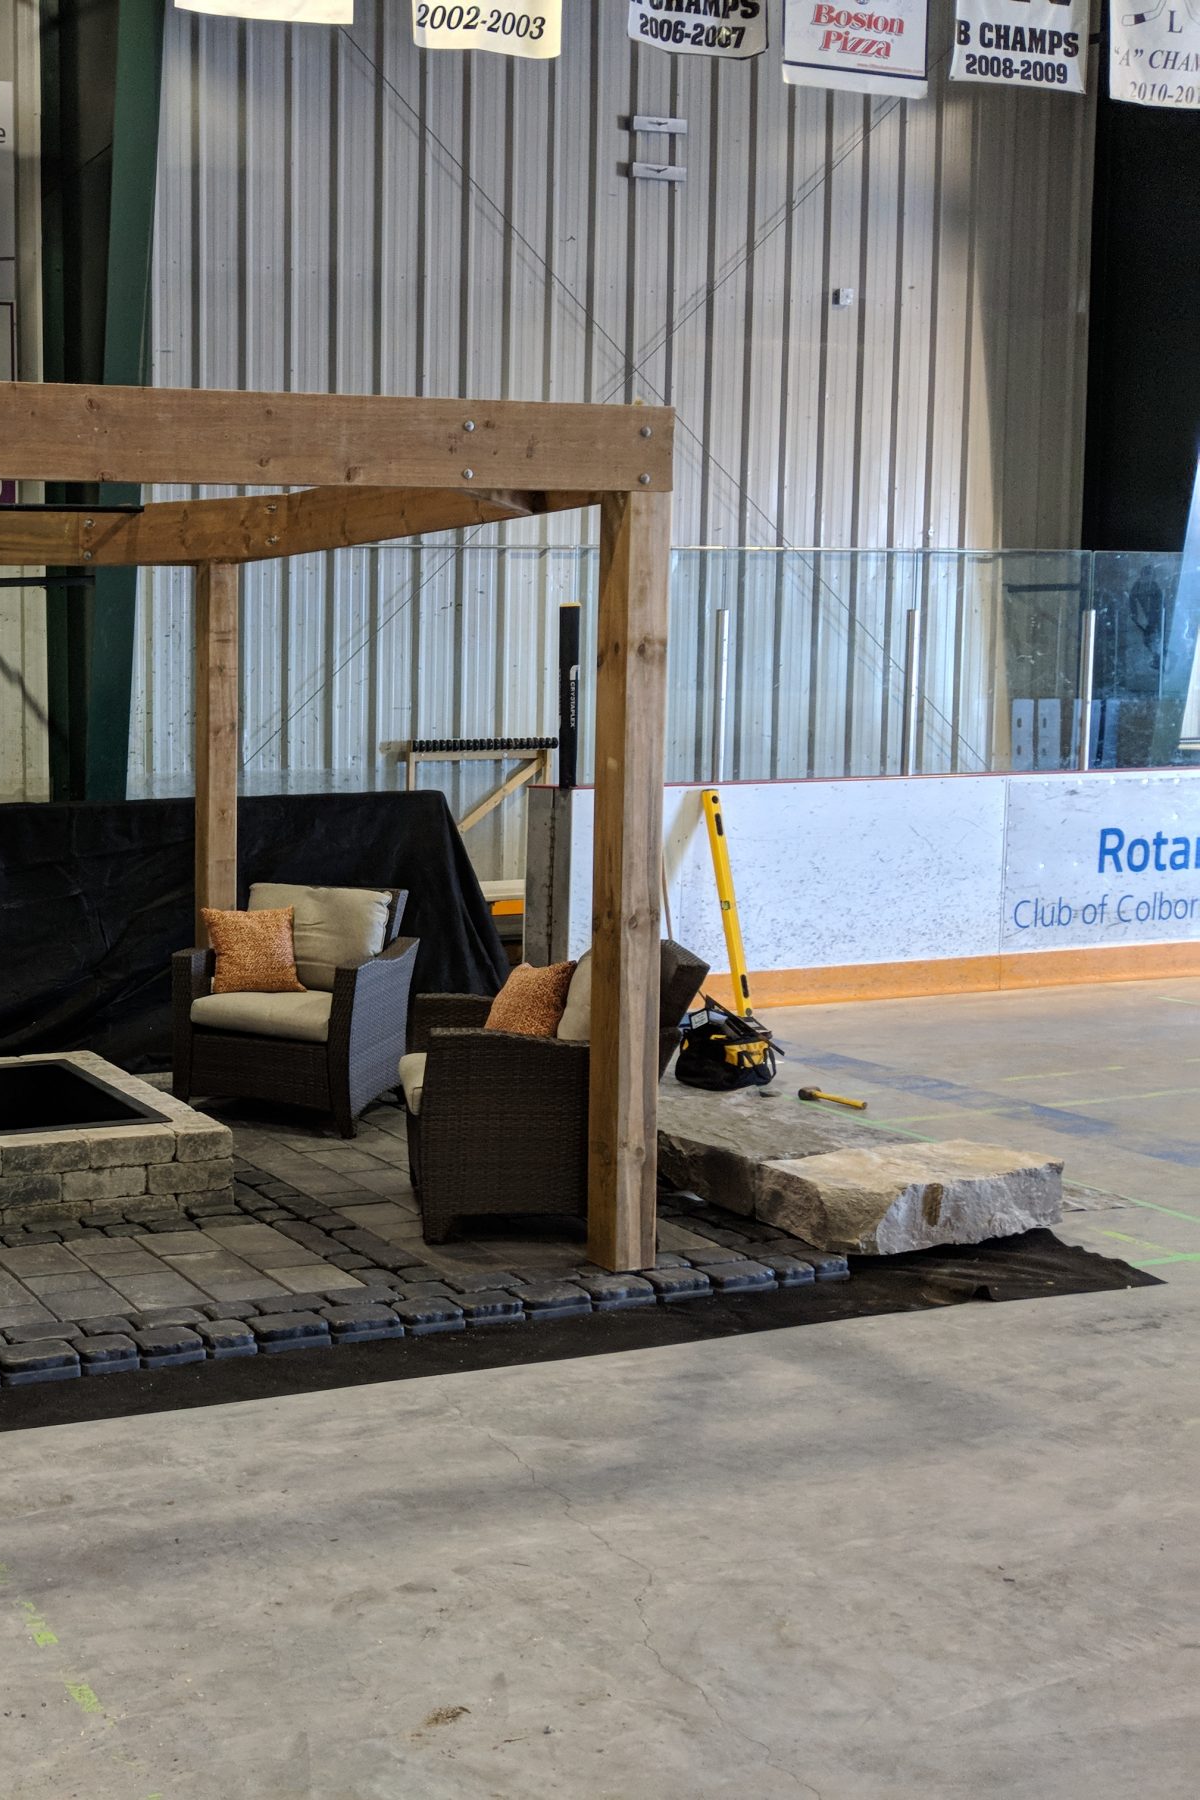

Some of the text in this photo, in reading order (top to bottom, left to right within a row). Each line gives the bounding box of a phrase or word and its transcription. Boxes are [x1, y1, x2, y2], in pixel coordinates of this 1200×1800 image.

[416, 4, 546, 39] 2002-2003
[639, 13, 746, 48] 2006-2007
[810, 3, 905, 36] Boston
[819, 29, 893, 60] Pizza
[956, 20, 1079, 57] B CHAMPS
[965, 53, 1068, 84] 2008-2009
[1014, 897, 1072, 929] Club
[1082, 894, 1109, 925] of
